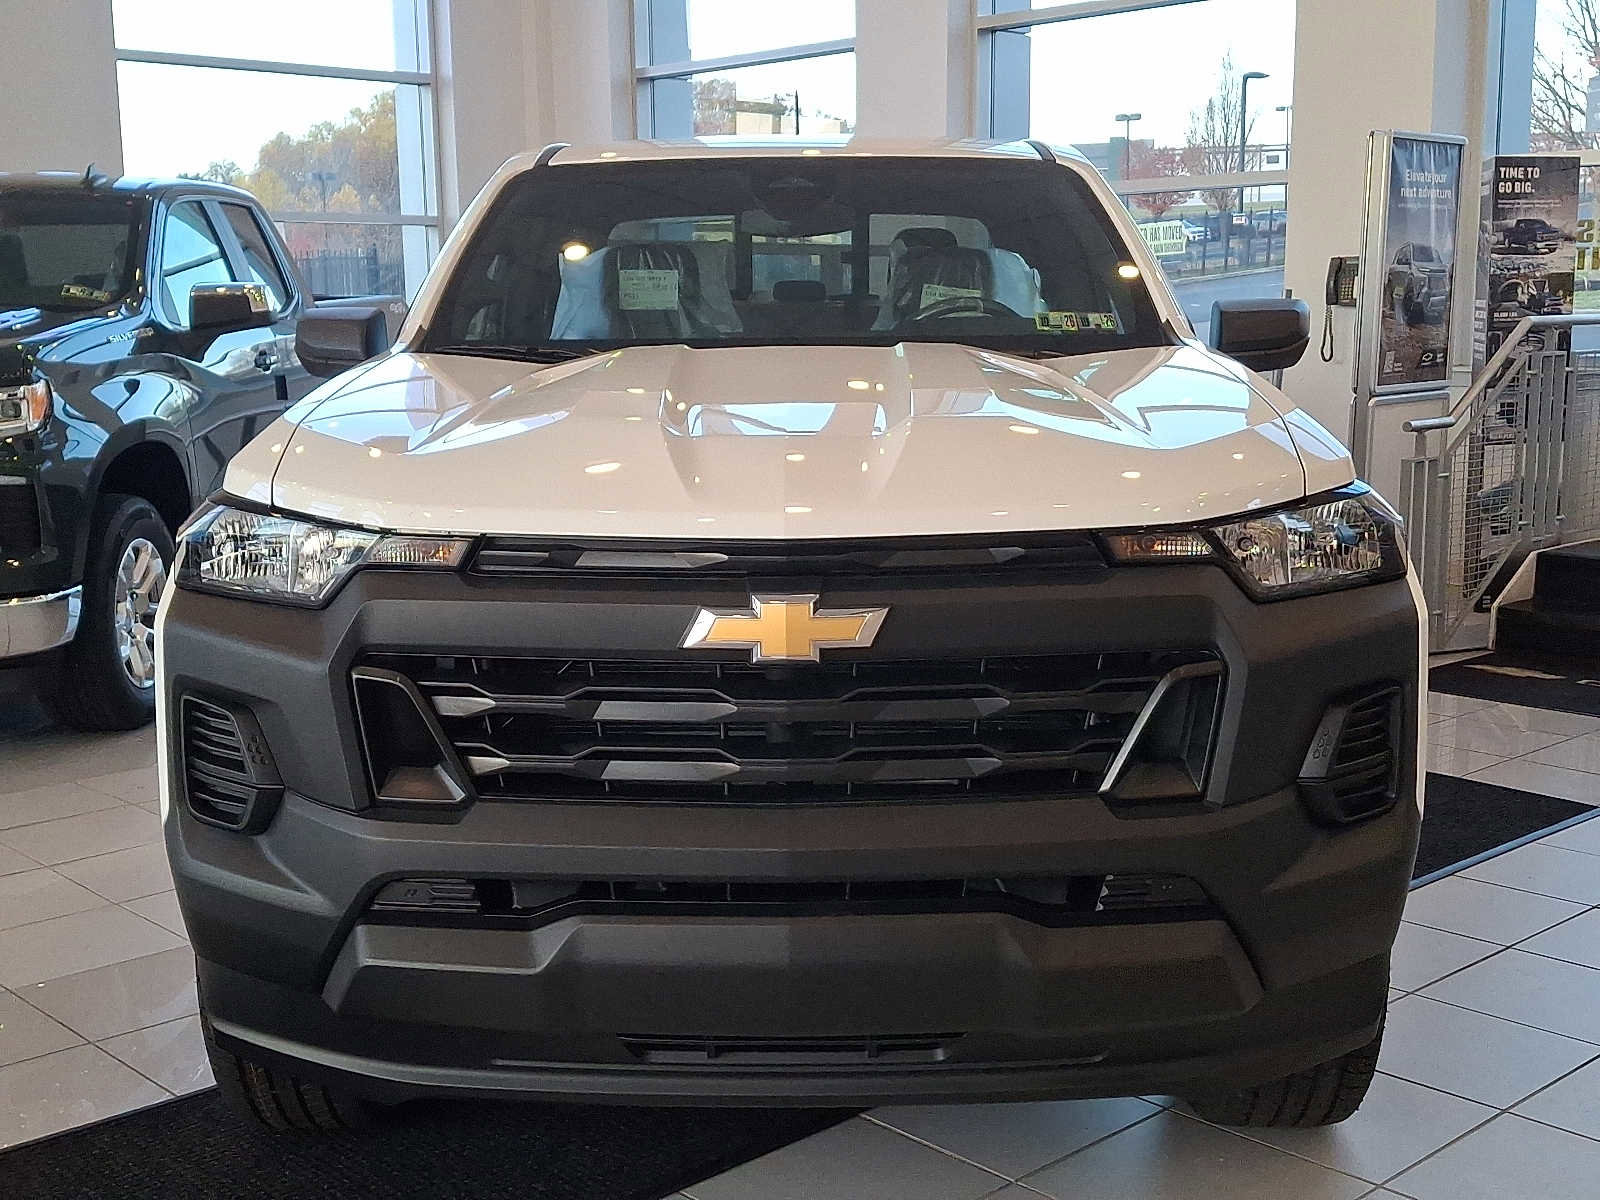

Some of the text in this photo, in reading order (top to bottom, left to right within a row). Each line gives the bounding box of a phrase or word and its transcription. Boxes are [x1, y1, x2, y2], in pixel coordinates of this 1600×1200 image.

[1406, 169, 1447, 185] Elevate your
[1499, 167, 1540, 179] TIME TO
[1400, 187, 1417, 198] next
[1498, 181, 1535, 194] GO BIG.
[1149, 226, 1160, 242] HAS
[1162, 225, 1182, 241] MOVED
[109, 327, 154, 343] SILVEDO
